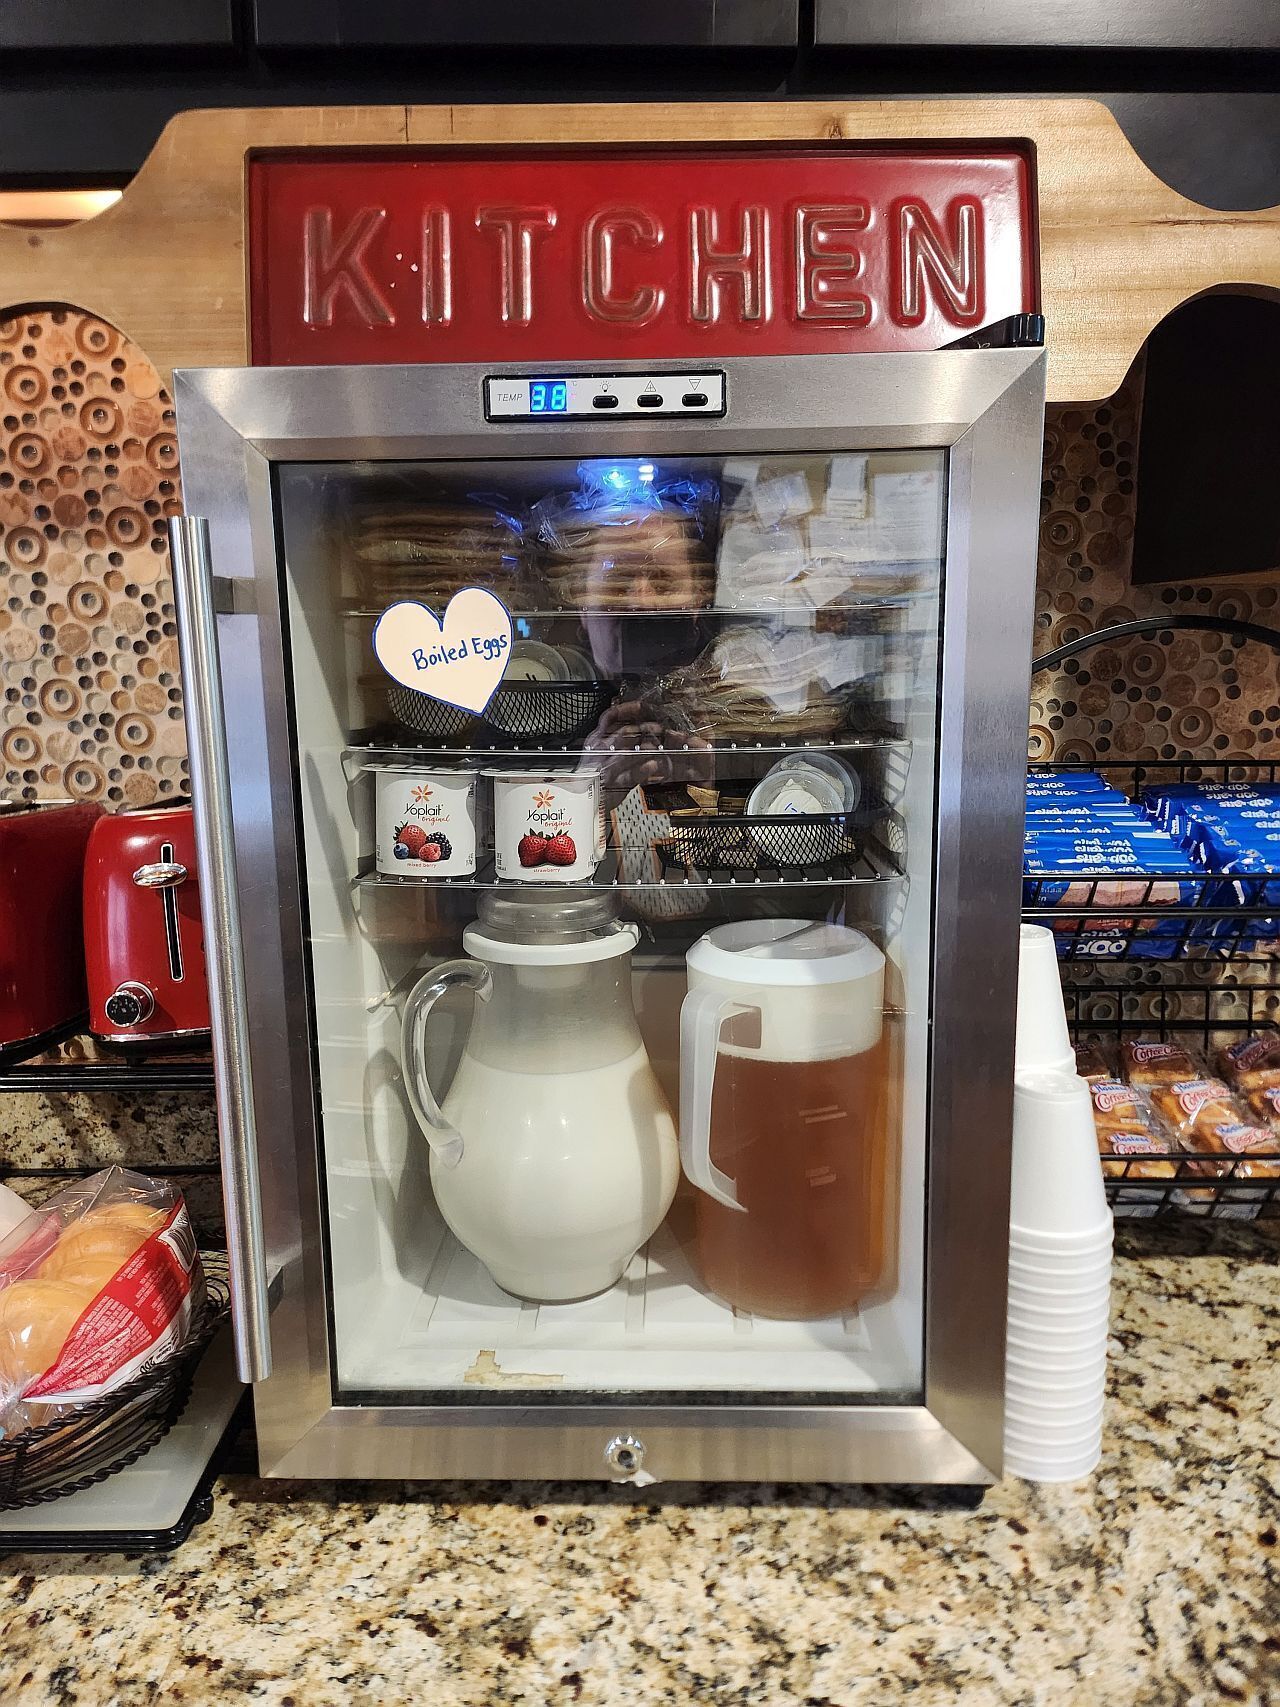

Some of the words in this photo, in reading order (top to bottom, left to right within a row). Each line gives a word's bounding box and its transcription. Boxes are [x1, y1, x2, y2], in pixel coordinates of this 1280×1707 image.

[301, 197, 986, 329] KITCHEN
[497, 393, 523, 402] TEMP
[531, 384, 567, 411] 38
[412, 640, 468, 670] Boiled
[471, 634, 508, 661] Eggs
[404, 803, 441, 819] Yoplait
[526, 808, 564, 825] Yoplait
[422, 815, 450, 826] original
[544, 818, 573, 831] original
[1133, 1047, 1163, 1064] Coffee
[1097, 1092, 1128, 1110] Coffee
